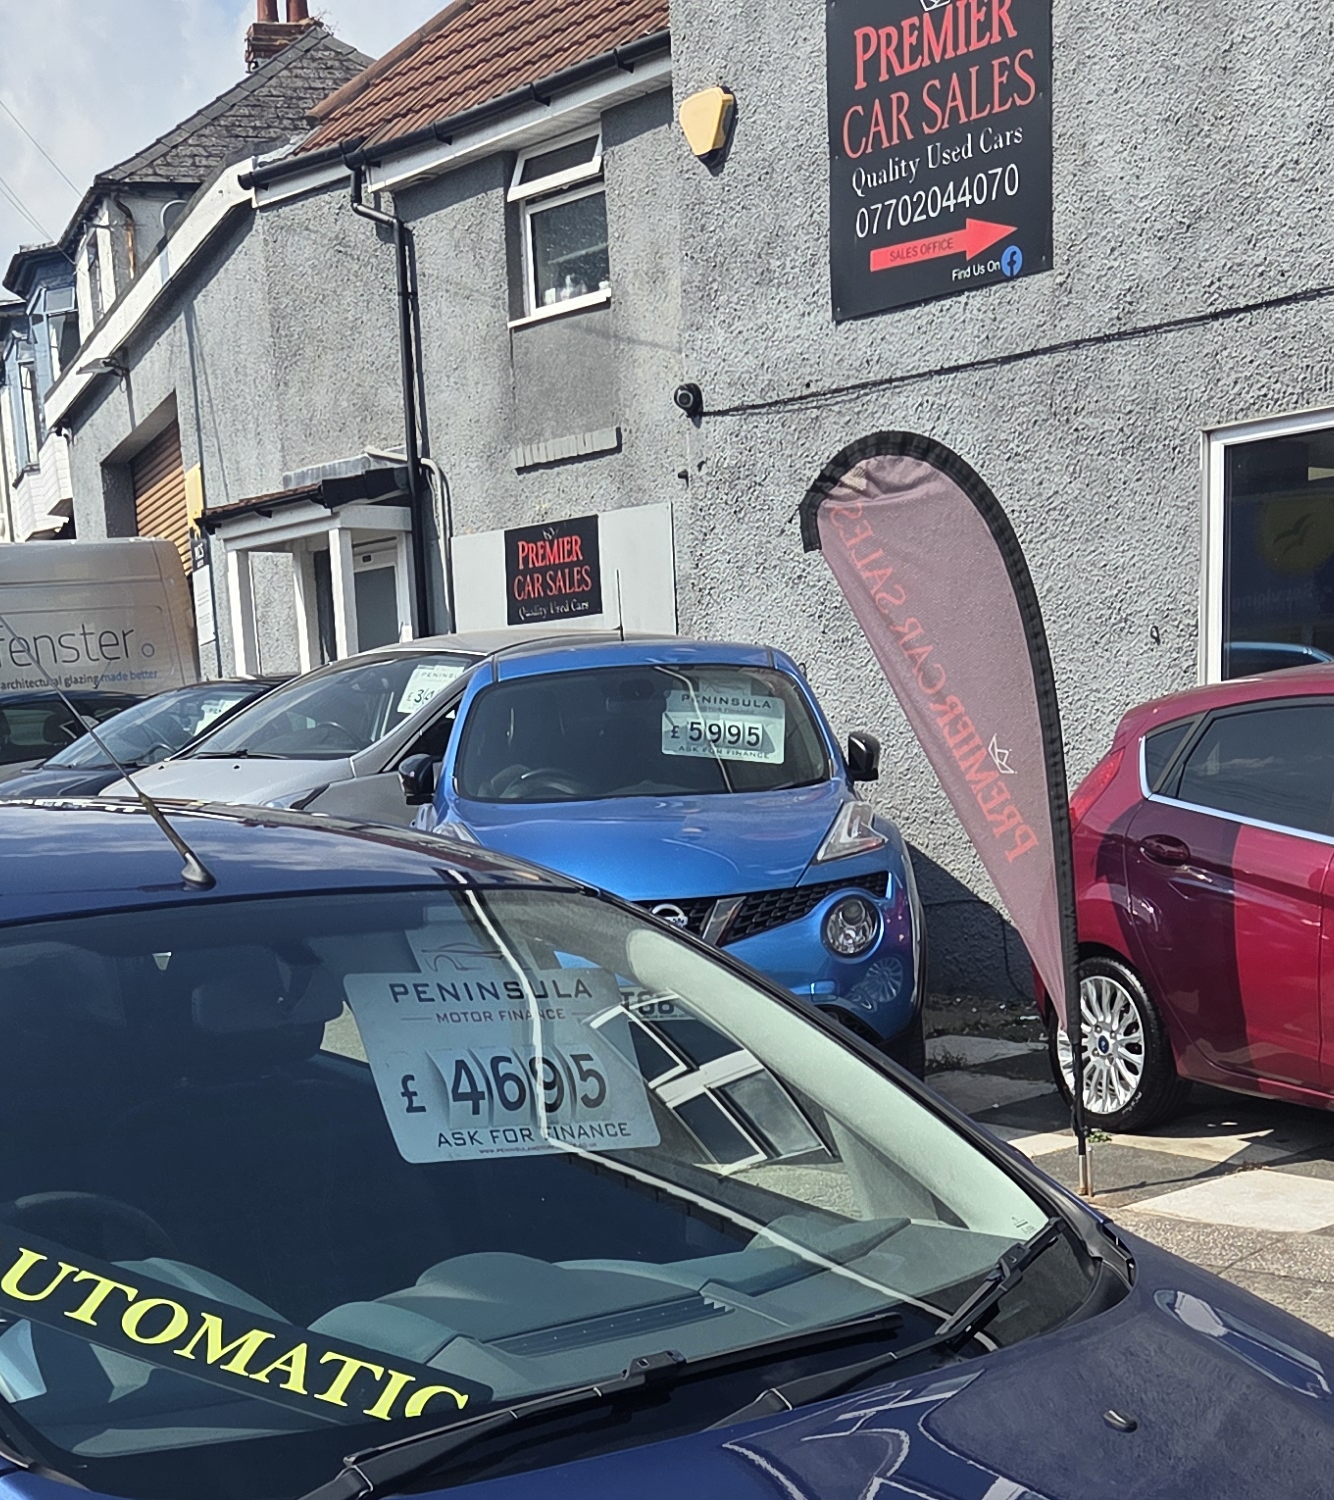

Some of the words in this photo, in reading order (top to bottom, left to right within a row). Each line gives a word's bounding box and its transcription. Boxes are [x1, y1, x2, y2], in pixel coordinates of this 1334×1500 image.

[854, 0, 1018, 90] PREMIER
[842, 91, 914, 158] CAR
[922, 48, 1036, 135] SALES
[852, 157, 920, 197] Quality
[927, 133, 973, 169] Used
[980, 127, 1023, 153] Cars
[856, 163, 1019, 238] 07702044070
[889, 245, 918, 262] SALES
[919, 237, 954, 256] OFFICE
[952, 265, 971, 281] Find
[972, 264, 985, 277] Us
[987, 260, 1000, 273] On
[518, 535, 583, 570] PREMIER
[514, 573, 544, 600] CAR
[546, 565, 592, 596] SALES
[64, 674, 101, 689] glazing
[129, 669, 158, 681] better
[681, 693, 772, 709] PENINSULA
[671, 725, 681, 739] £
[688, 721, 761, 747] 5995
[389, 977, 593, 1003] PENINSULA
[436, 1009, 493, 1025] MOTOR
[499, 1007, 566, 1022] FINANCE
[400, 1074, 427, 1114] £
[450, 1053, 608, 1117] 4695
[438, 1130, 484, 1148] ASK
[490, 1127, 536, 1145] FOR
[544, 1122, 632, 1142] FINANCE
